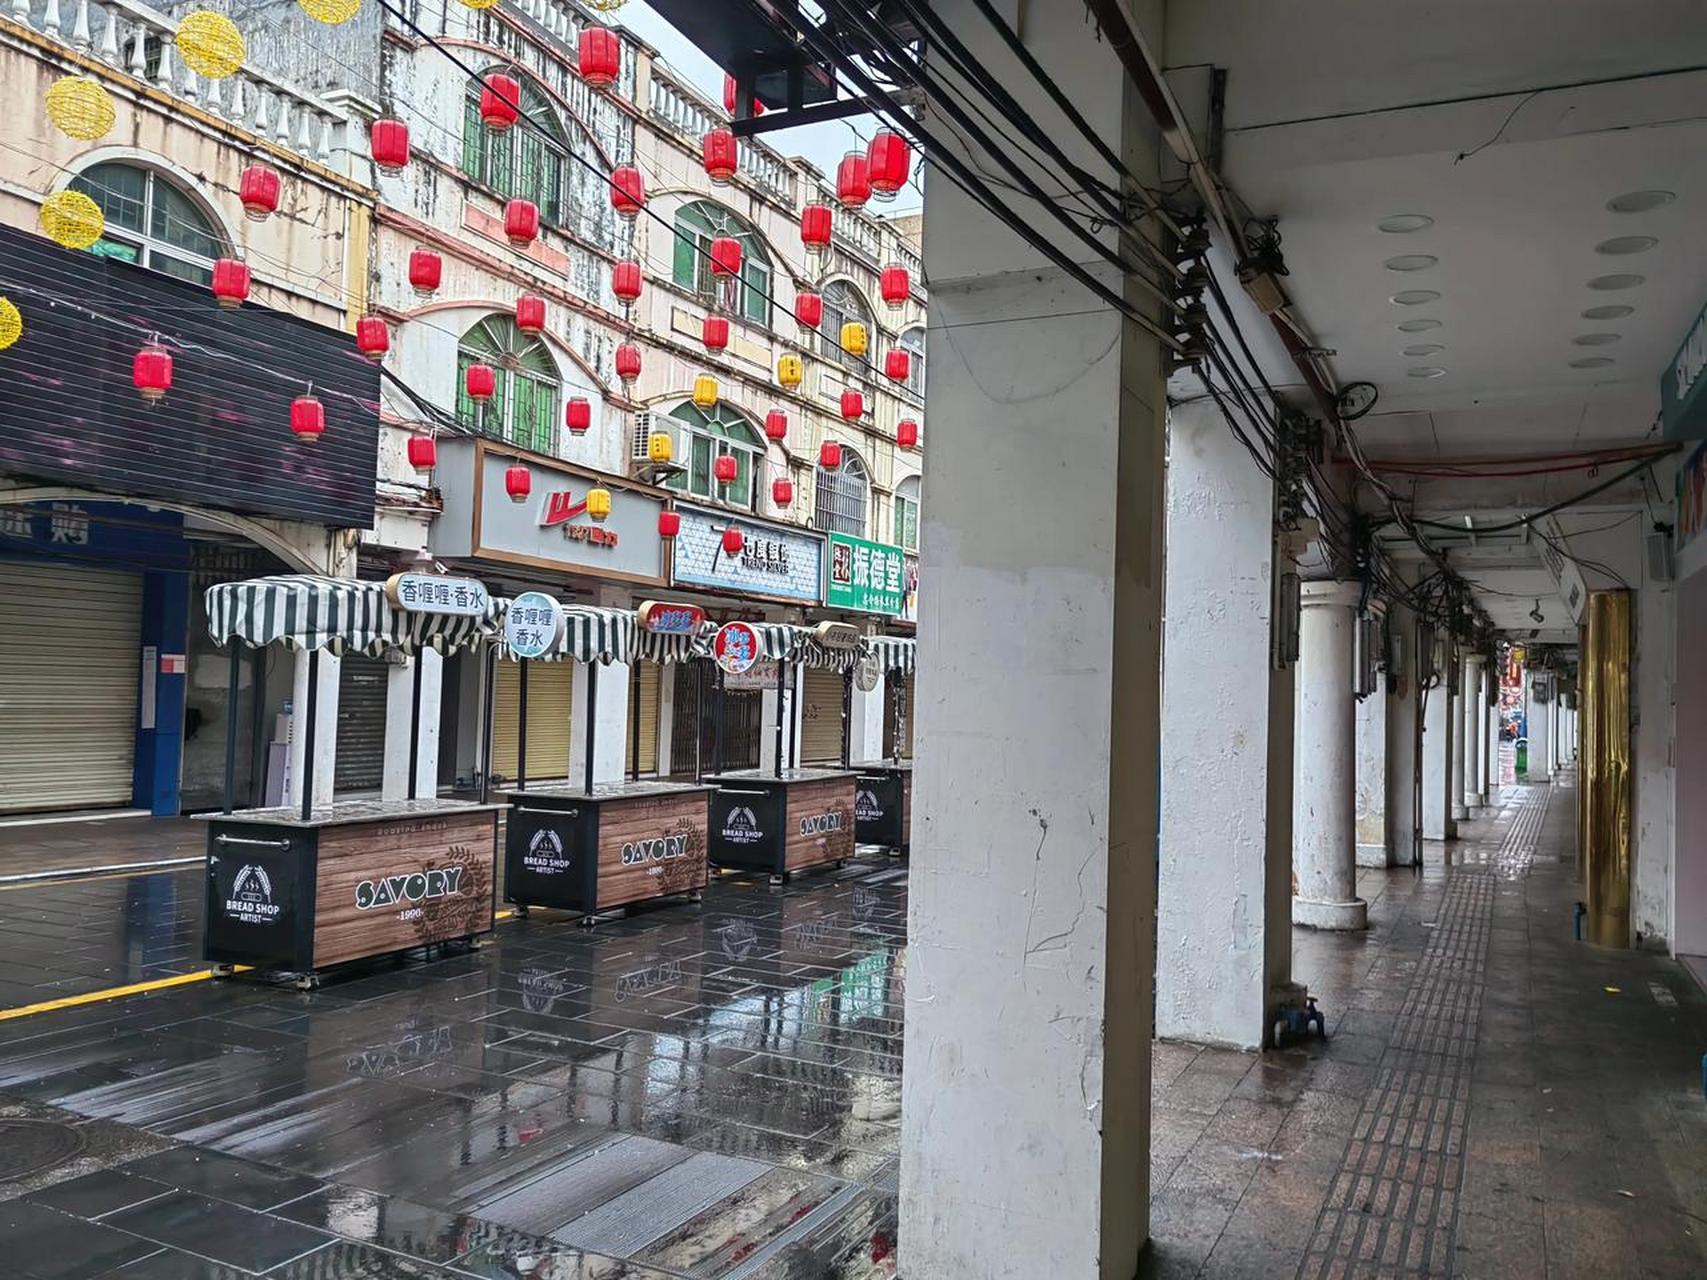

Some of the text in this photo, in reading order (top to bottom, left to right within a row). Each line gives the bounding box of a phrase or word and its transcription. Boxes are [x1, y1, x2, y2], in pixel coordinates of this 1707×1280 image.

[853, 544, 901, 593] 振德堂
[511, 607, 553, 626] 香喱喱
[516, 629, 543, 647] 香水
[799, 811, 842, 837] SAVORY
[722, 828, 764, 839] BREAD SHOP
[732, 836, 750, 844] ARTIST
[620, 833, 689, 866] SAVORY
[523, 856, 570, 868] BREAD SHOP
[535, 865, 555, 874] ARTIST
[355, 866, 463, 911] SAVORY
[226, 899, 280, 916] BREAD SHOP
[240, 914, 263, 924] ARTIST
